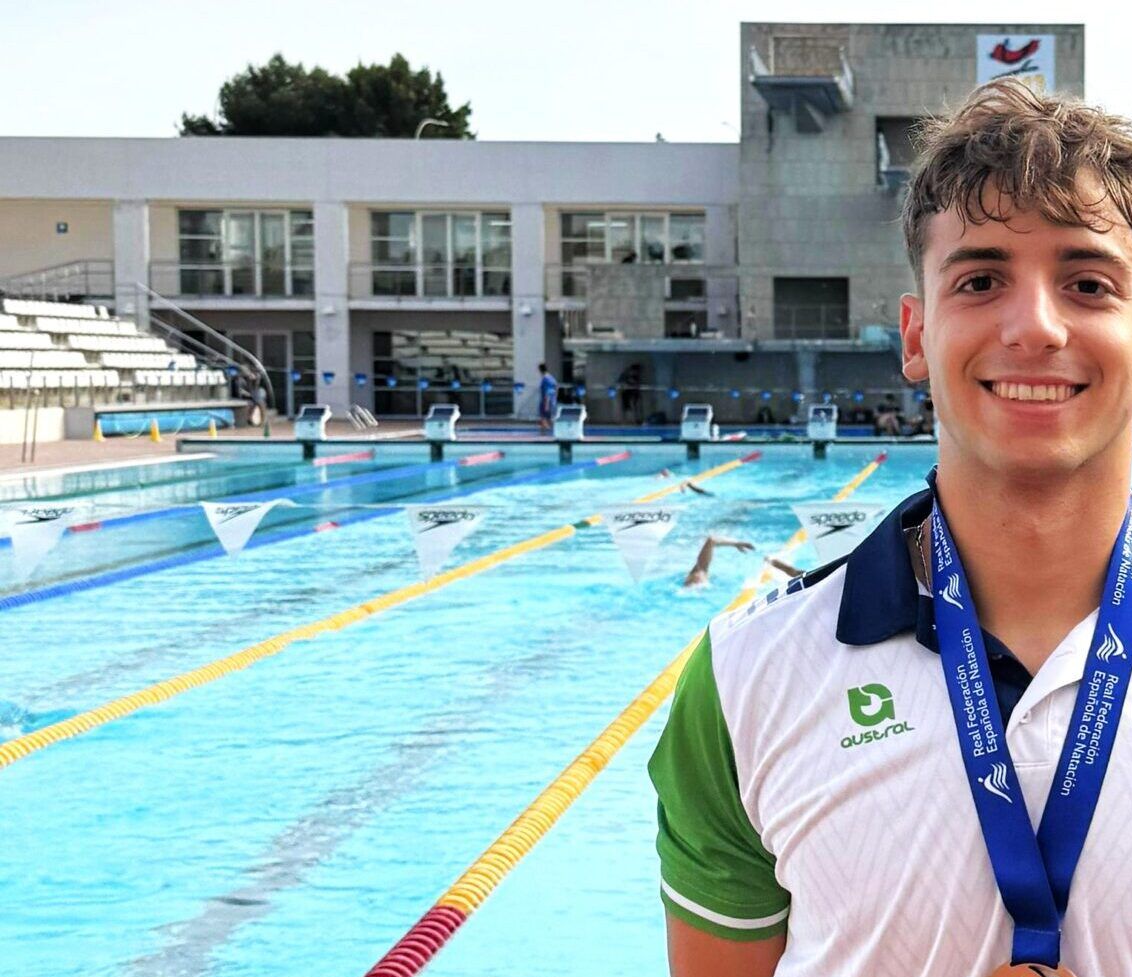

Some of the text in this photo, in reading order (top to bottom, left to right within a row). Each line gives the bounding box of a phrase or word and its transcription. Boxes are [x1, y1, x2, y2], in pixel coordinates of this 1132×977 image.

[810, 510, 866, 525] speedo
[1112, 556, 1132, 606] Natación
[840, 721, 916, 748] austral
[956, 664, 985, 758] Real Federación
[962, 628, 999, 754] Española de Natación
[1060, 670, 1106, 796] Española de Natación
[1085, 674, 1119, 765] Real Federación
